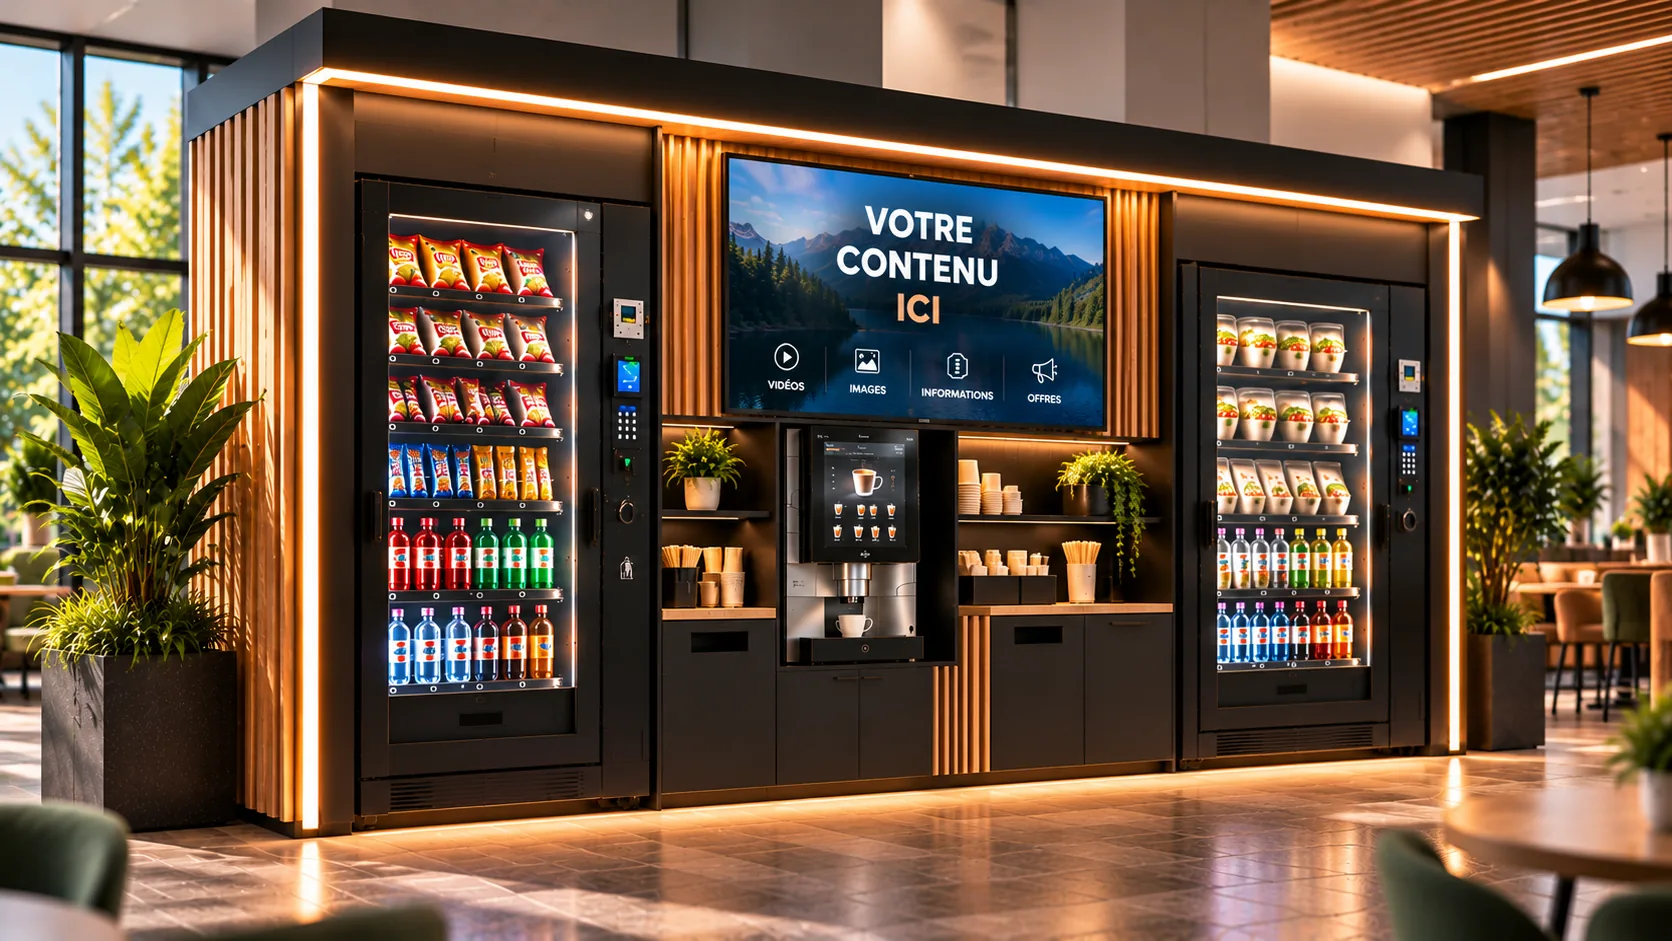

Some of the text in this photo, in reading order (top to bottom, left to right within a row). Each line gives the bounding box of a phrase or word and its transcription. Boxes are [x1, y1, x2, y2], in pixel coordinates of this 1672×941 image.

[864, 205, 973, 244] VOTRE
[836, 245, 998, 287] CONTENU
[897, 293, 940, 324] ICI
[767, 378, 805, 392] VIDÉOS
[849, 384, 887, 395] IMAGES
[921, 388, 994, 401] INFORMATIONS
[1027, 393, 1062, 404] OFFRES
